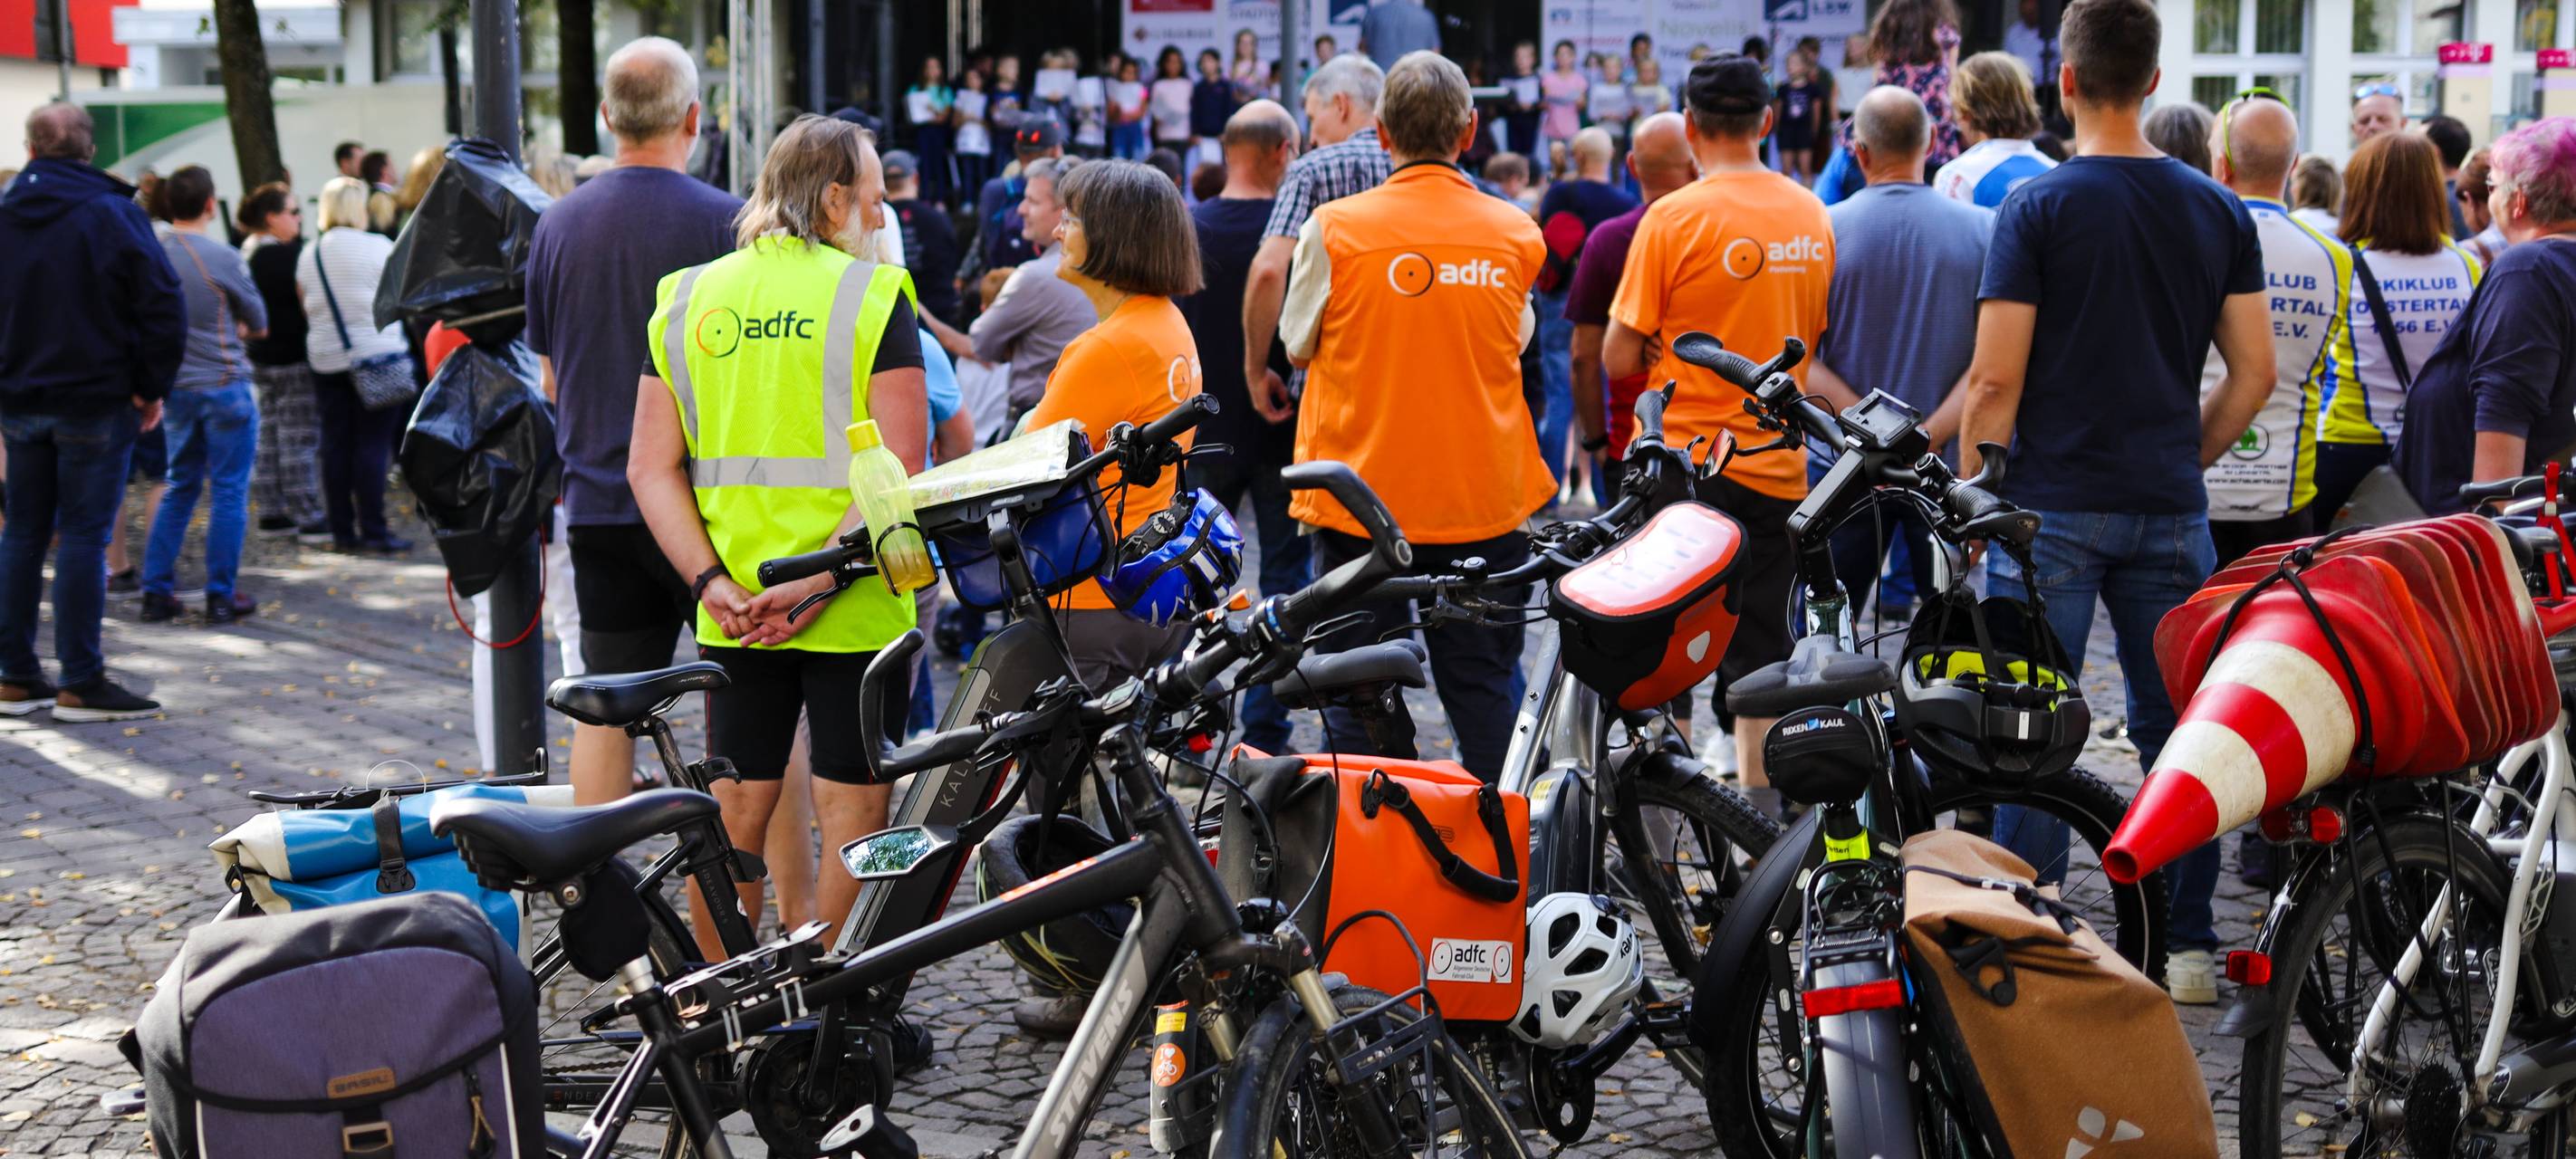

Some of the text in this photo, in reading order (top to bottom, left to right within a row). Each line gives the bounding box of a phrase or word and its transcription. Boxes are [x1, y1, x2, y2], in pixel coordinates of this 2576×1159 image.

[1658, 18, 1748, 37] Novelis
[1767, 235, 1824, 262] adfc
[1438, 258, 1507, 289] adfc
[2266, 273, 2317, 290] LUB
[2355, 297, 2467, 314] OSTERTA
[744, 310, 815, 340] adfc
[2273, 321, 2310, 340] E.V.
[2370, 320, 2417, 334] 156
[1782, 718, 1846, 737] RIXEN KAUL
[1454, 943, 1486, 963] adfc
[1050, 979, 1133, 1149] STEVENS
